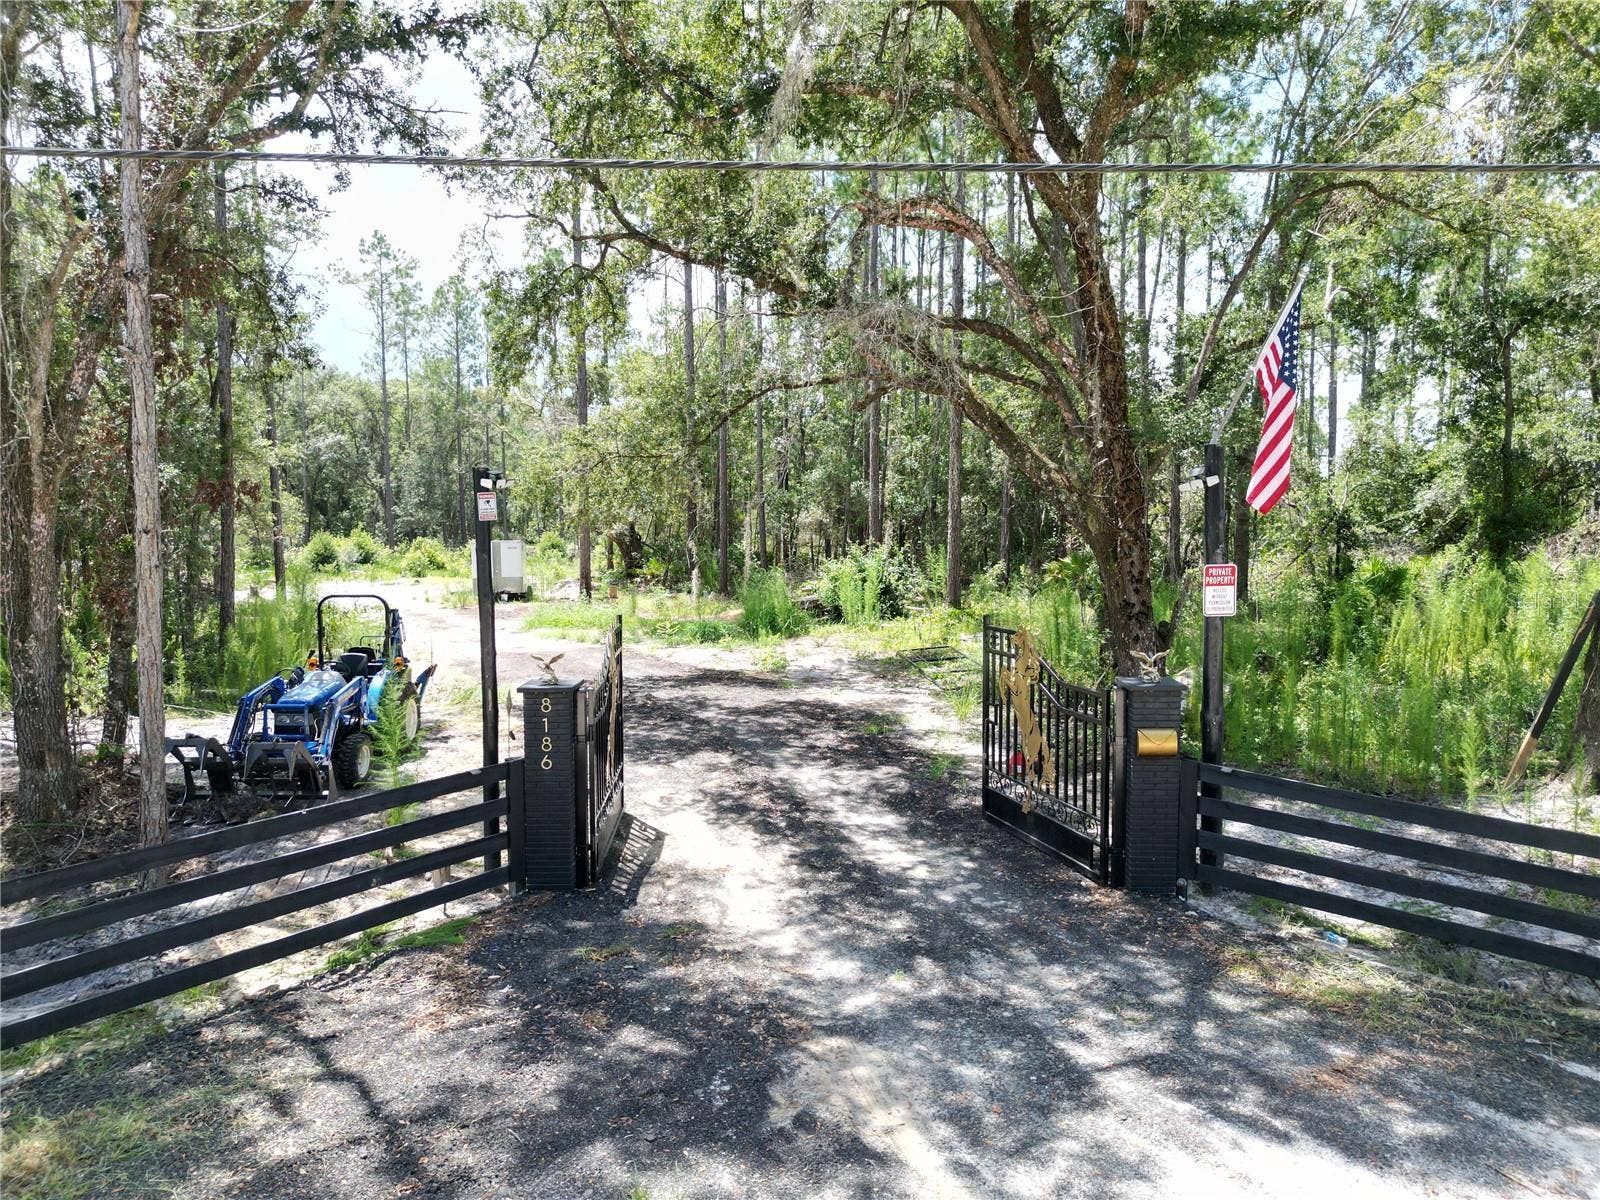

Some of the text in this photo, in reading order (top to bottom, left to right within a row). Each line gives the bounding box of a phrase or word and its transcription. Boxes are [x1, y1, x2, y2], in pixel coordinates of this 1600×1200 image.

[1208, 567, 1232, 576] PRIVATE
[1205, 576, 1235, 585] PROPERTY
[541, 697, 552, 770] 8186
